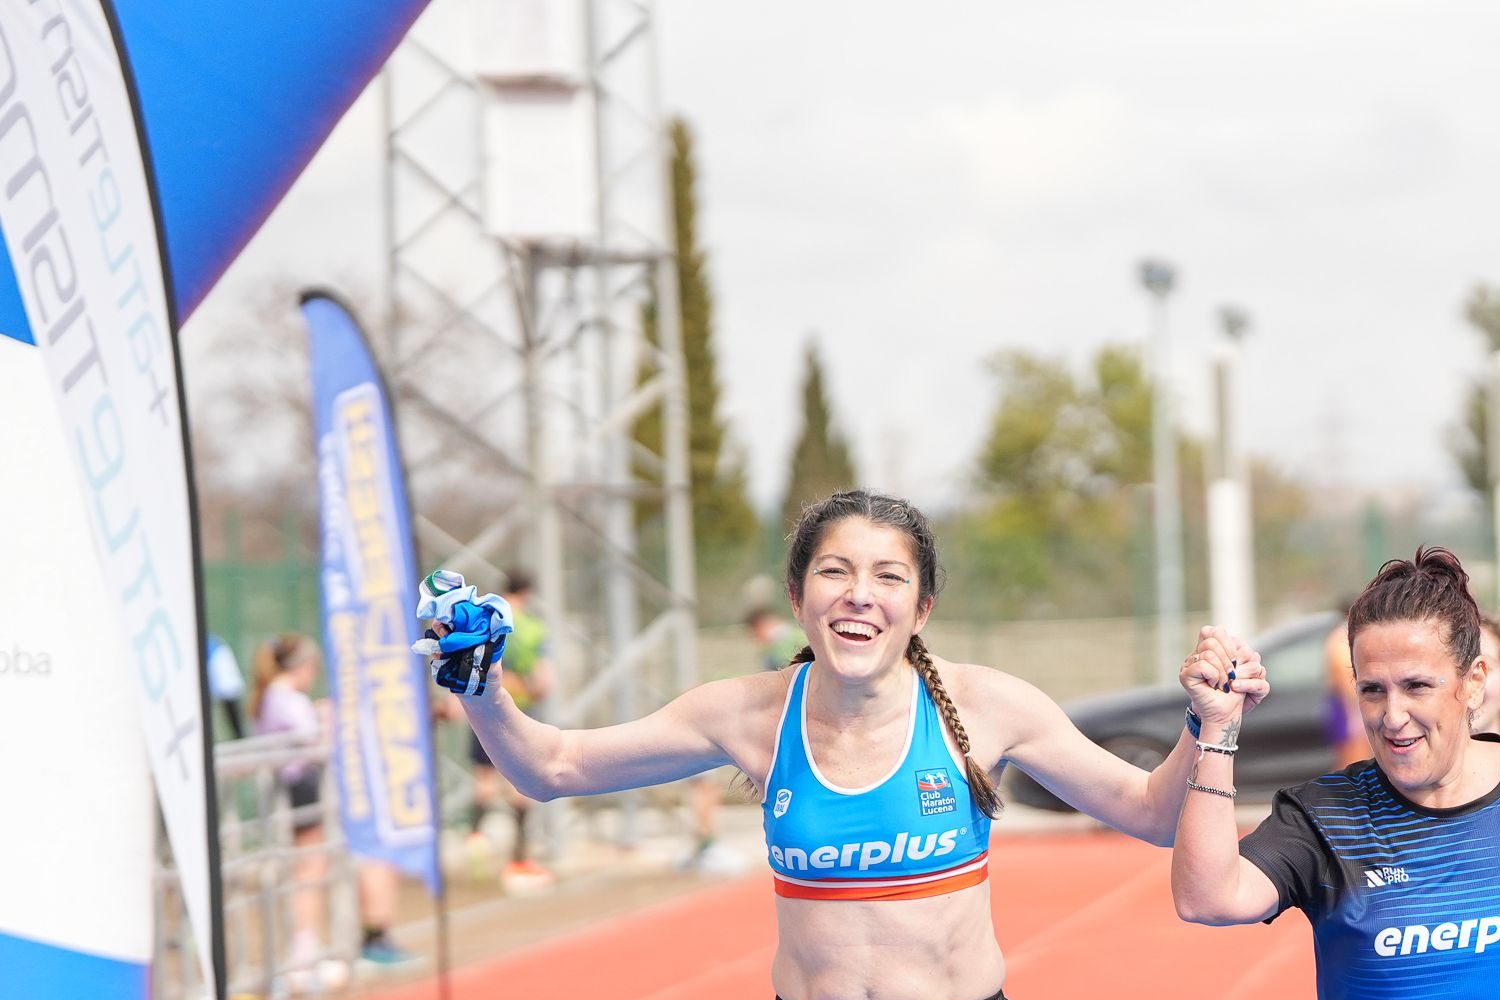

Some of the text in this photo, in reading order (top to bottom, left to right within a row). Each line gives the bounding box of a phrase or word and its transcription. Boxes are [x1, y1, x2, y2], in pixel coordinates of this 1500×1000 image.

[921, 791, 941, 800] Club
[922, 797, 955, 807] Maratón
[923, 805, 954, 815] Lucena
[770, 829, 959, 871] enerplus
[1382, 867, 1405, 876] RUN
